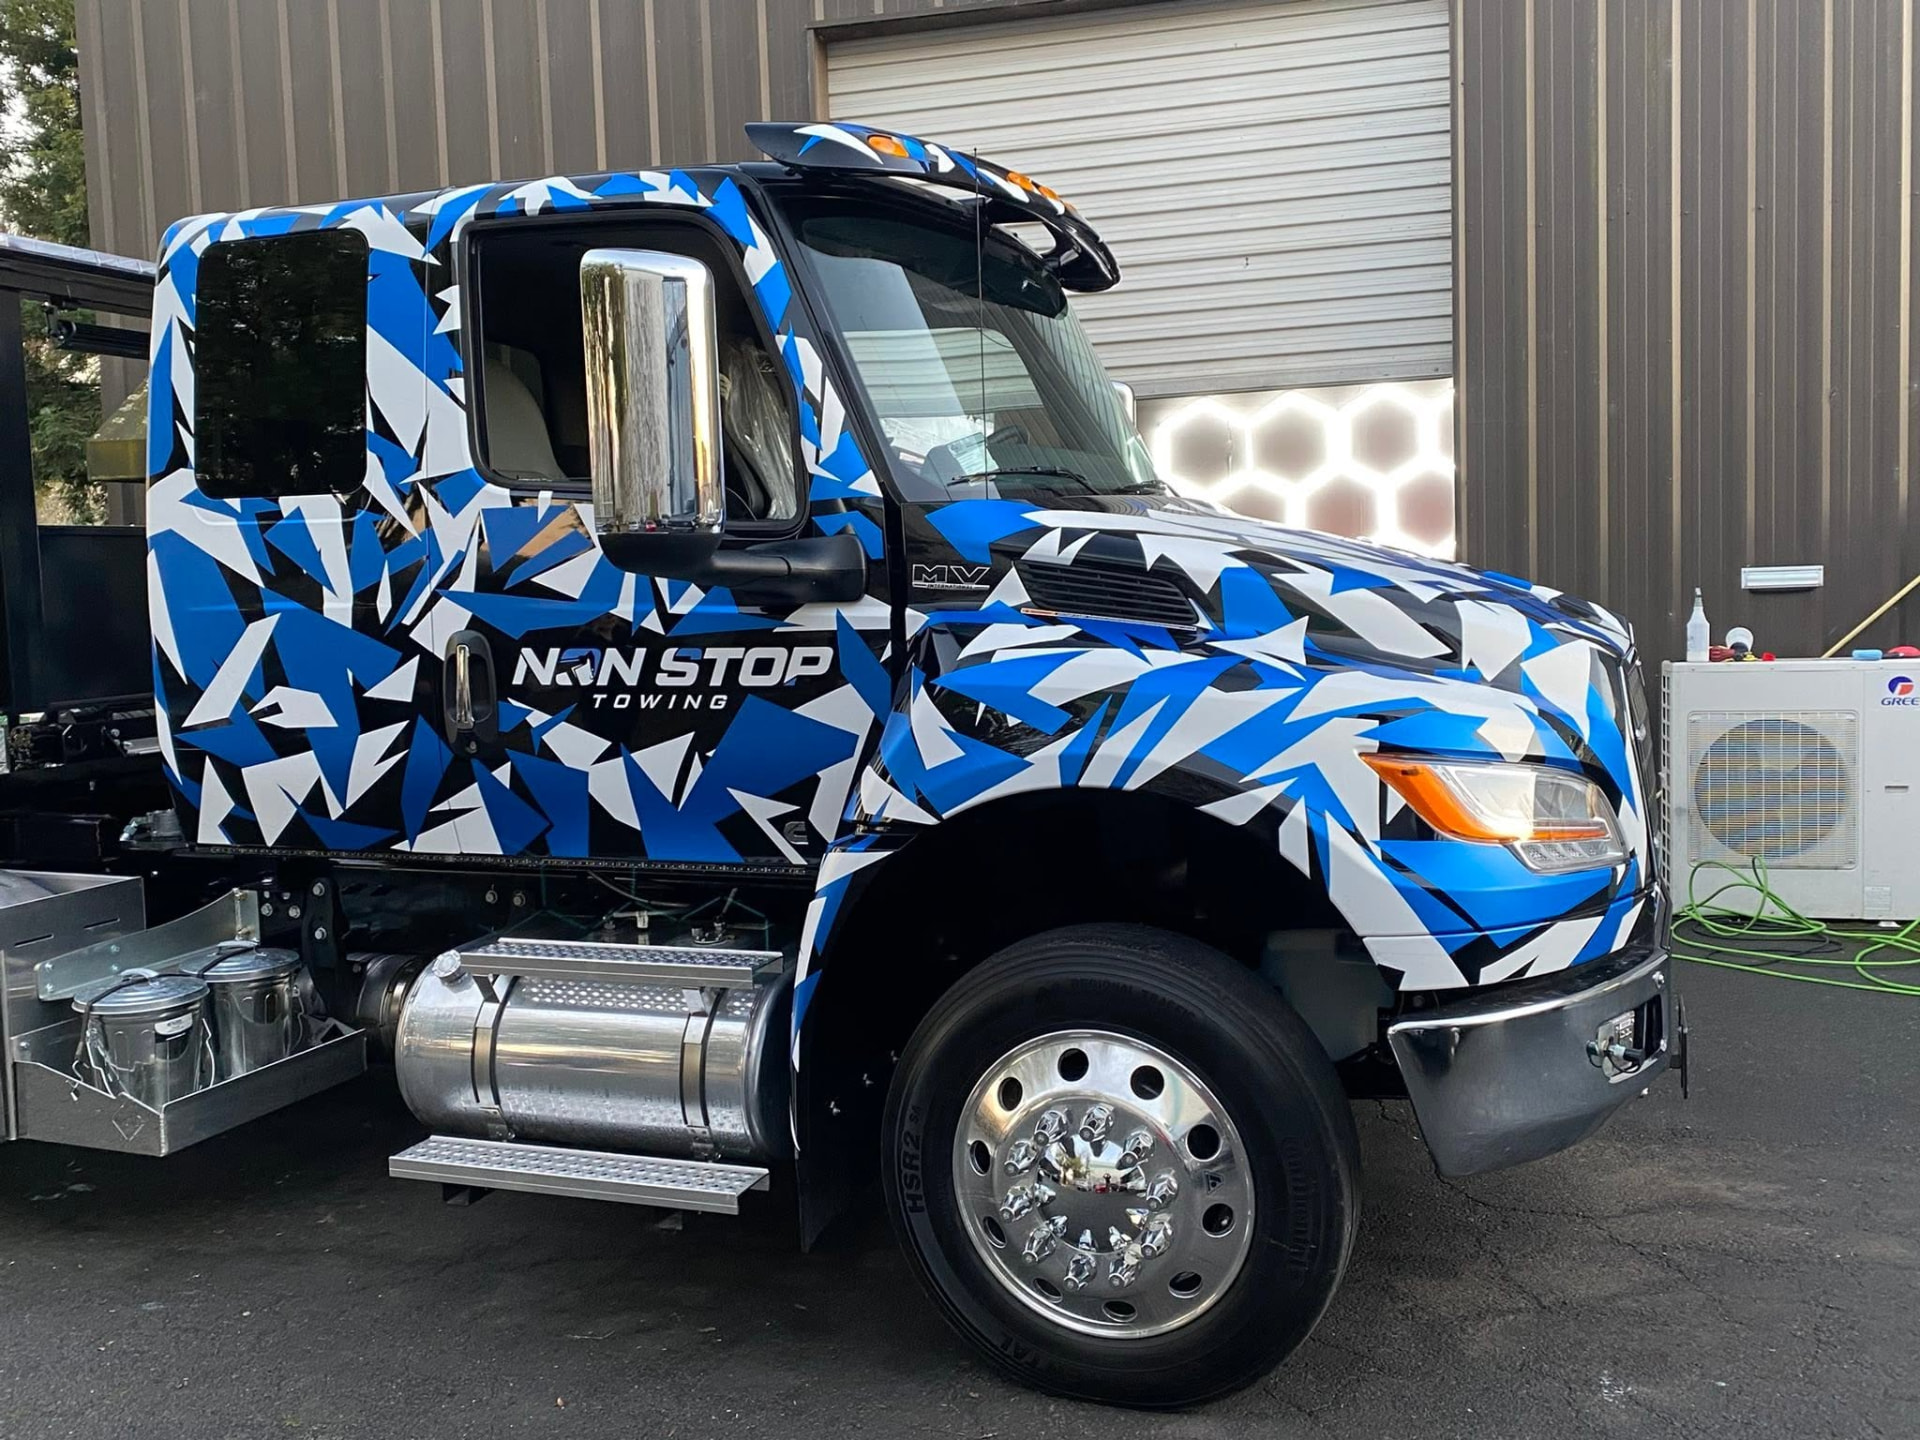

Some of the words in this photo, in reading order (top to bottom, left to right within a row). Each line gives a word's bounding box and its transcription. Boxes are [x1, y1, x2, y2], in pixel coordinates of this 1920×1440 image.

[912, 564, 991, 584] MV
[655, 646, 834, 686] STOP
[592, 694, 728, 710] TOWING
[1881, 697, 1920, 706] GREE
[901, 1131, 925, 1214] HSR2
